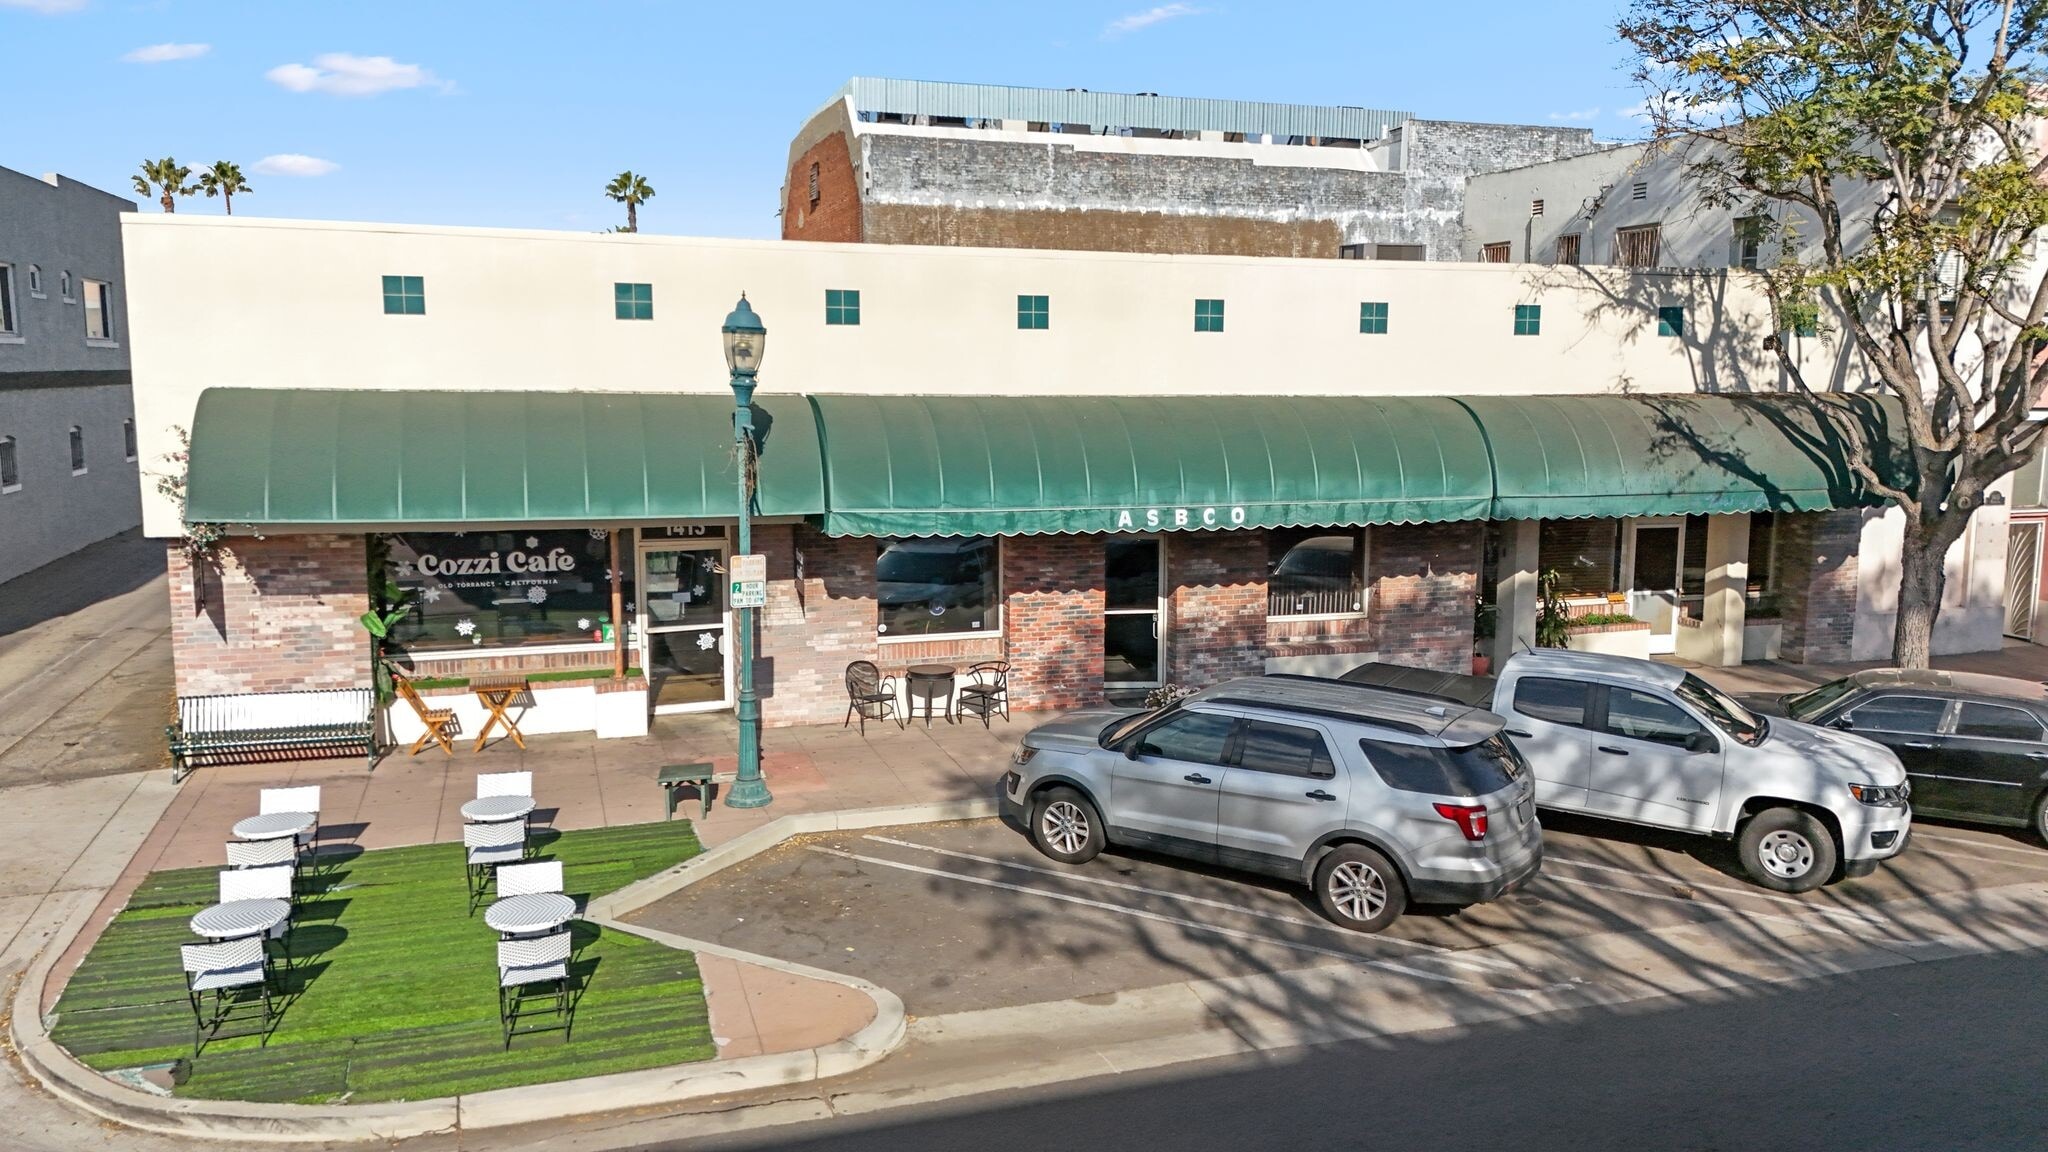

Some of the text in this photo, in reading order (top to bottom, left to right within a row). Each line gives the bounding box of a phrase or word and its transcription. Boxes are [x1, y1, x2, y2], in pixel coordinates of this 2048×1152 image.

[1118, 507, 1245, 527] ASBCO
[417, 548, 575, 576] Cozzi Cafe
[505, 578, 558, 587] CALIFORNIA
[735, 583, 740, 593] 2
